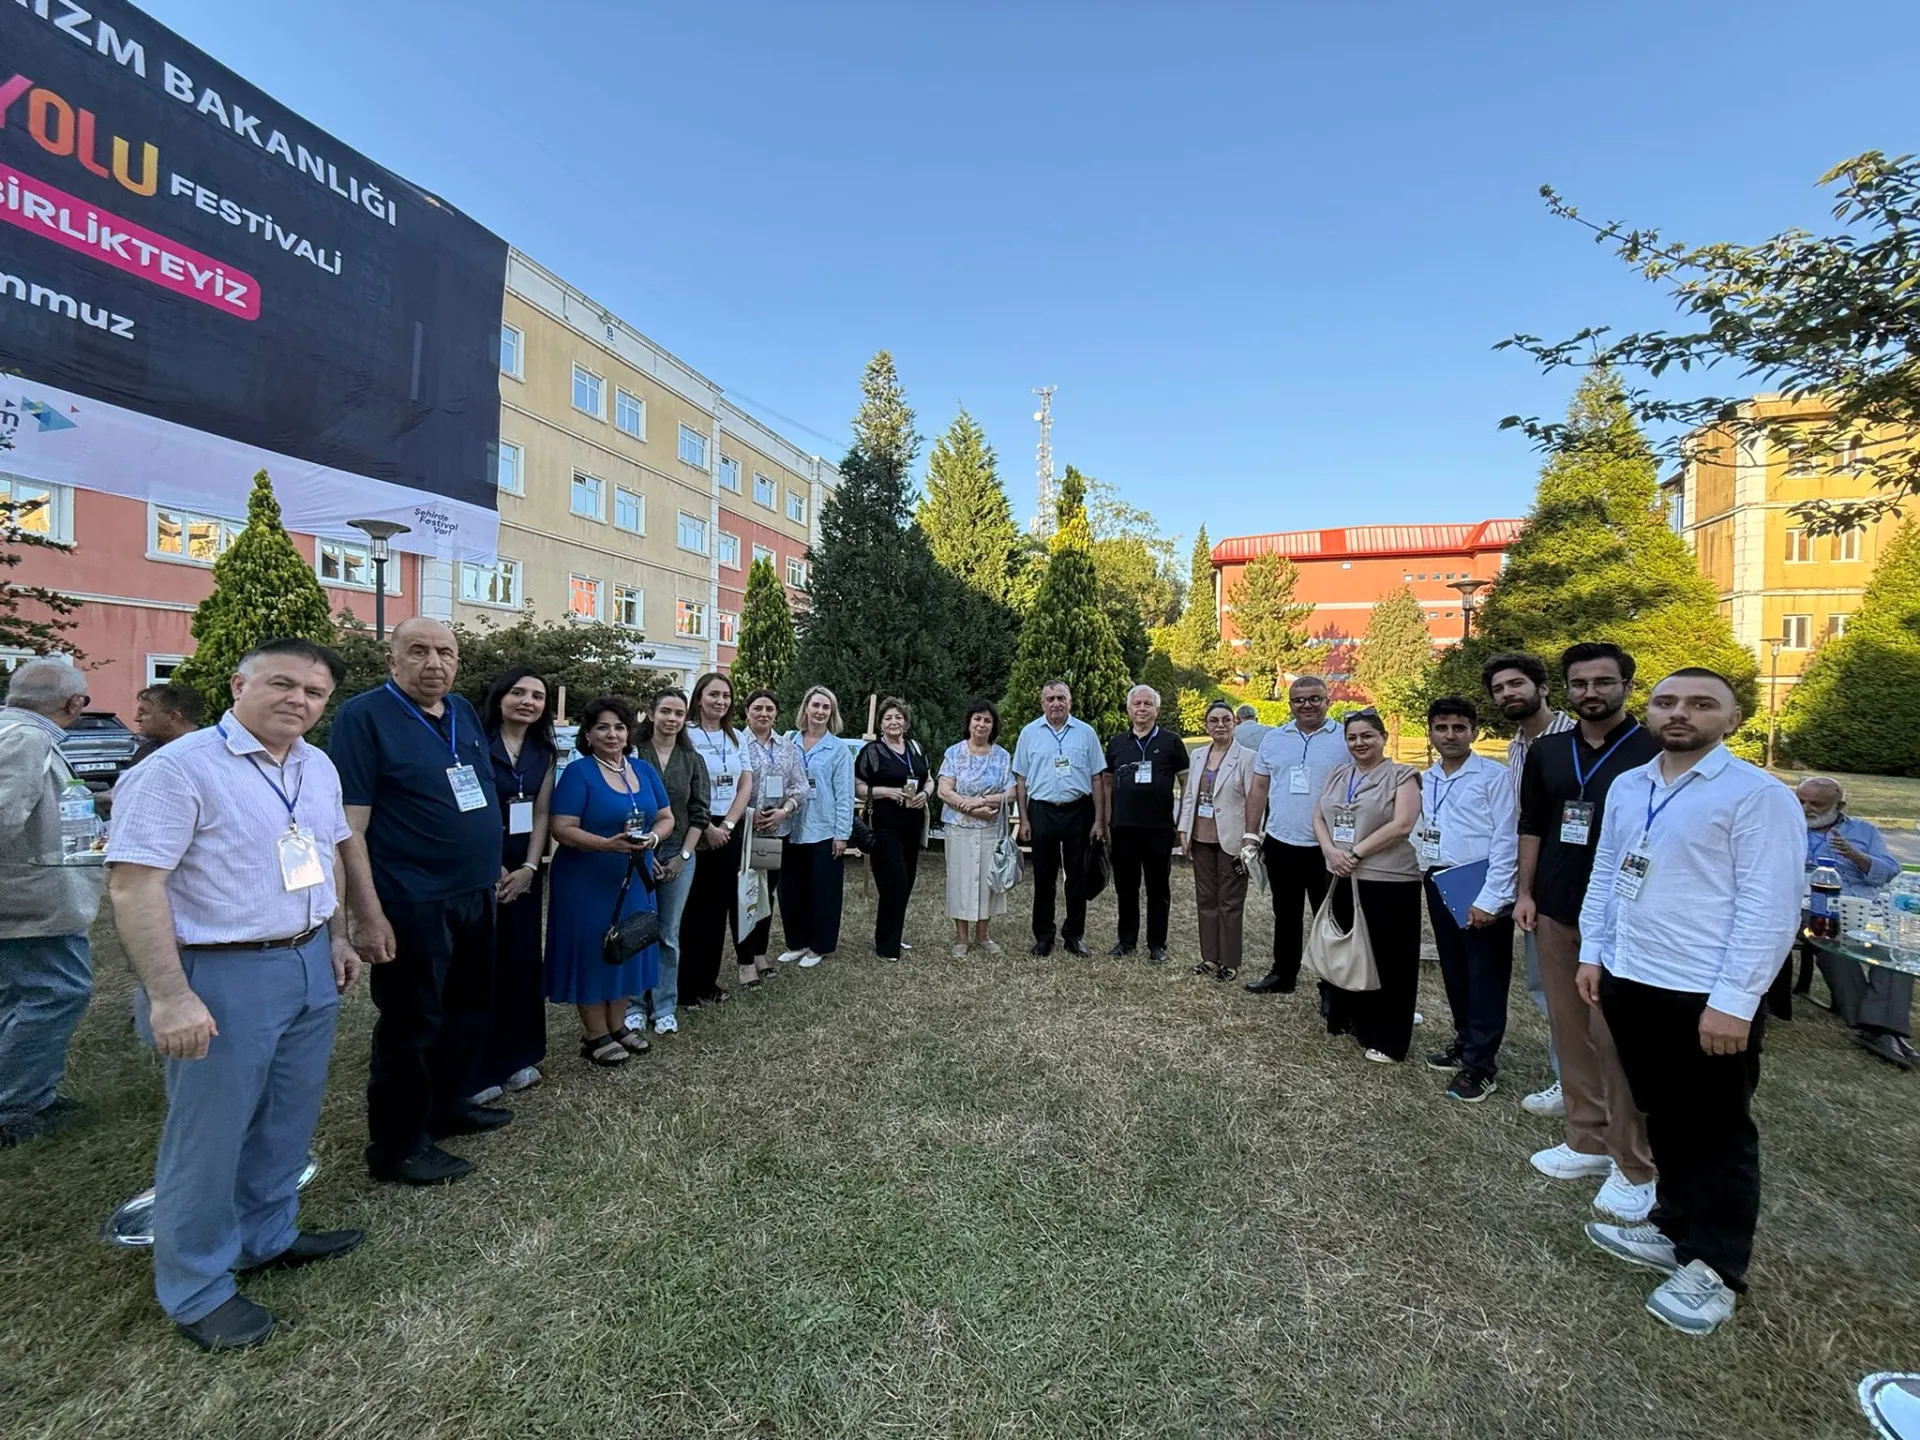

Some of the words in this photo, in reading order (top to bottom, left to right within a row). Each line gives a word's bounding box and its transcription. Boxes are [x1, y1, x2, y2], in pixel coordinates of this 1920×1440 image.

[163, 61, 397, 228] BAKANLIĞI
[0, 175, 249, 309] İRLİKTEYİZ
[170, 172, 343, 276] FESTİVALİ
[418, 515, 459, 532] Festival
